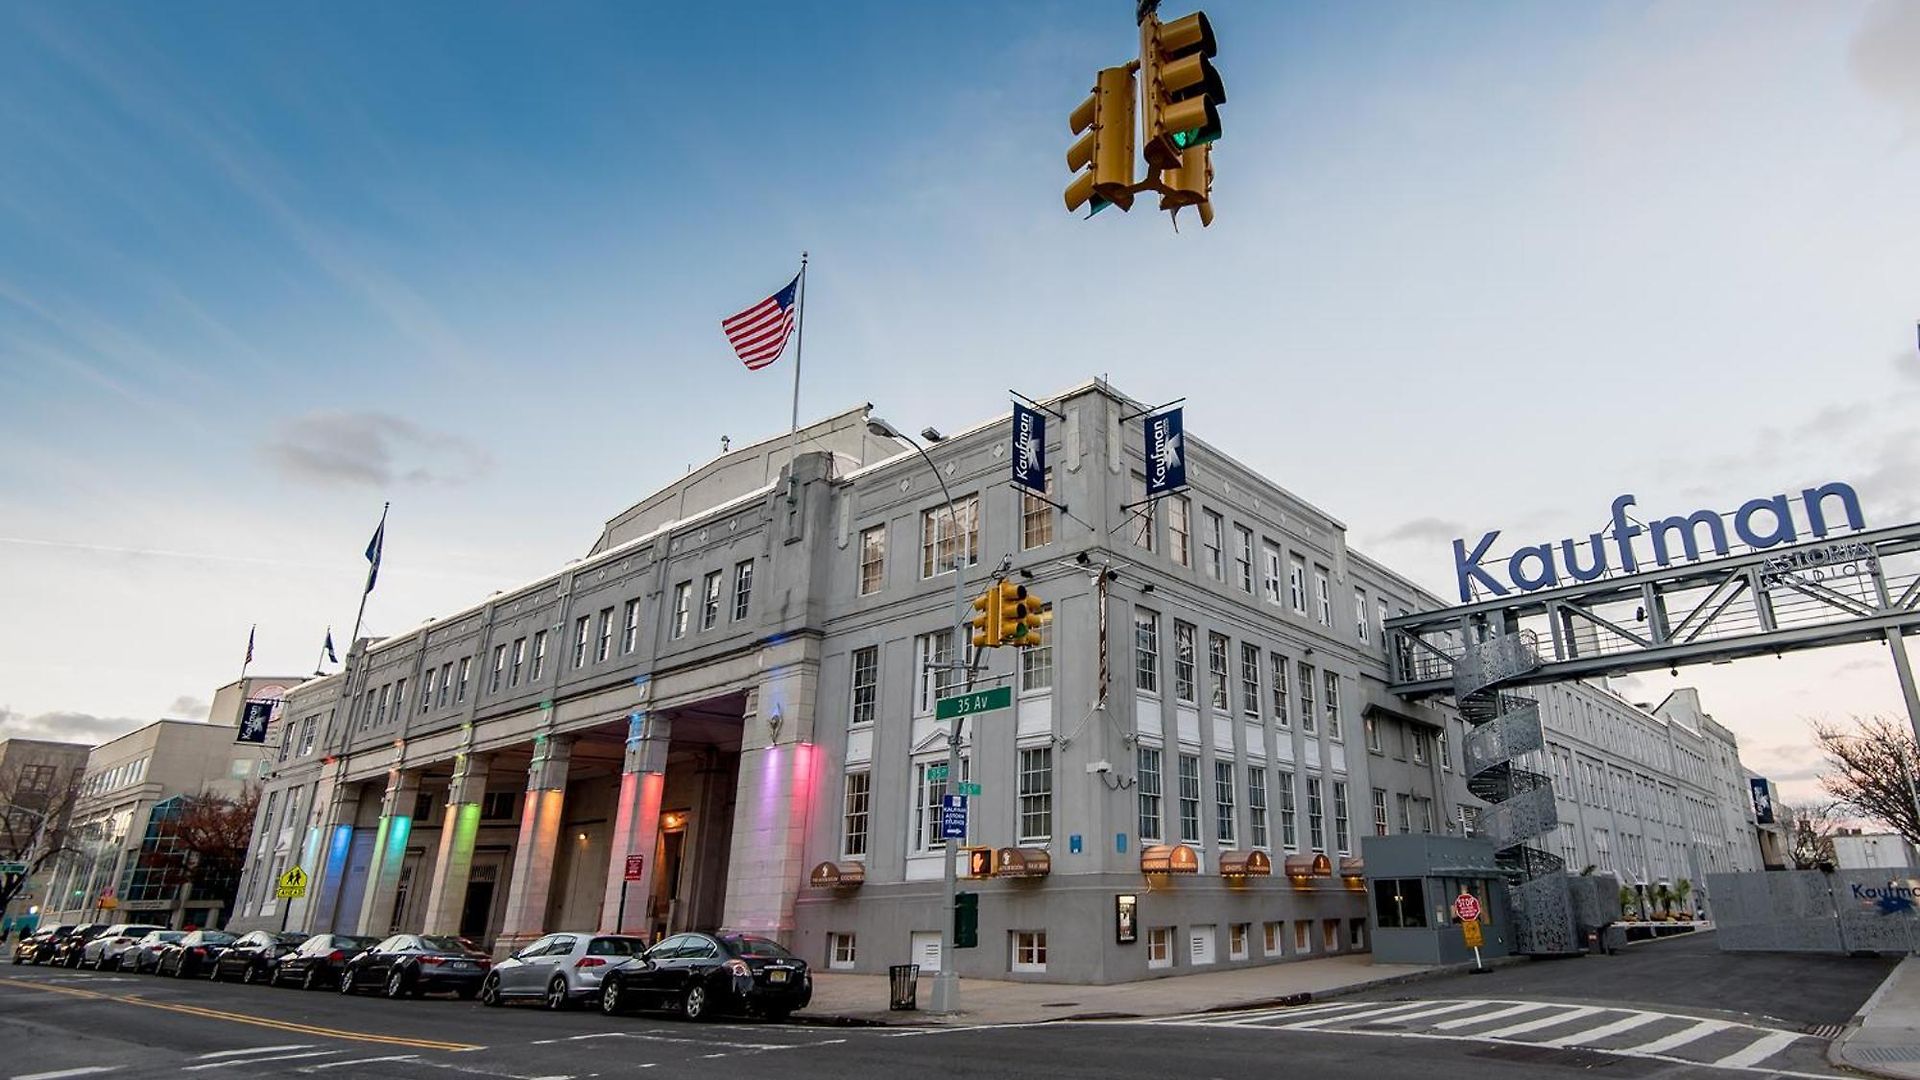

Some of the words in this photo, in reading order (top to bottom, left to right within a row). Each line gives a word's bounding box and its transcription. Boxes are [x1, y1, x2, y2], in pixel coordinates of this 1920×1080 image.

[1015, 412, 1030, 481] Kaufman
[1150, 420, 1166, 489] Kaufman
[1452, 481, 1867, 603] Kaufman
[957, 698, 970, 713] 35
[1459, 898, 1474, 908] STOP
